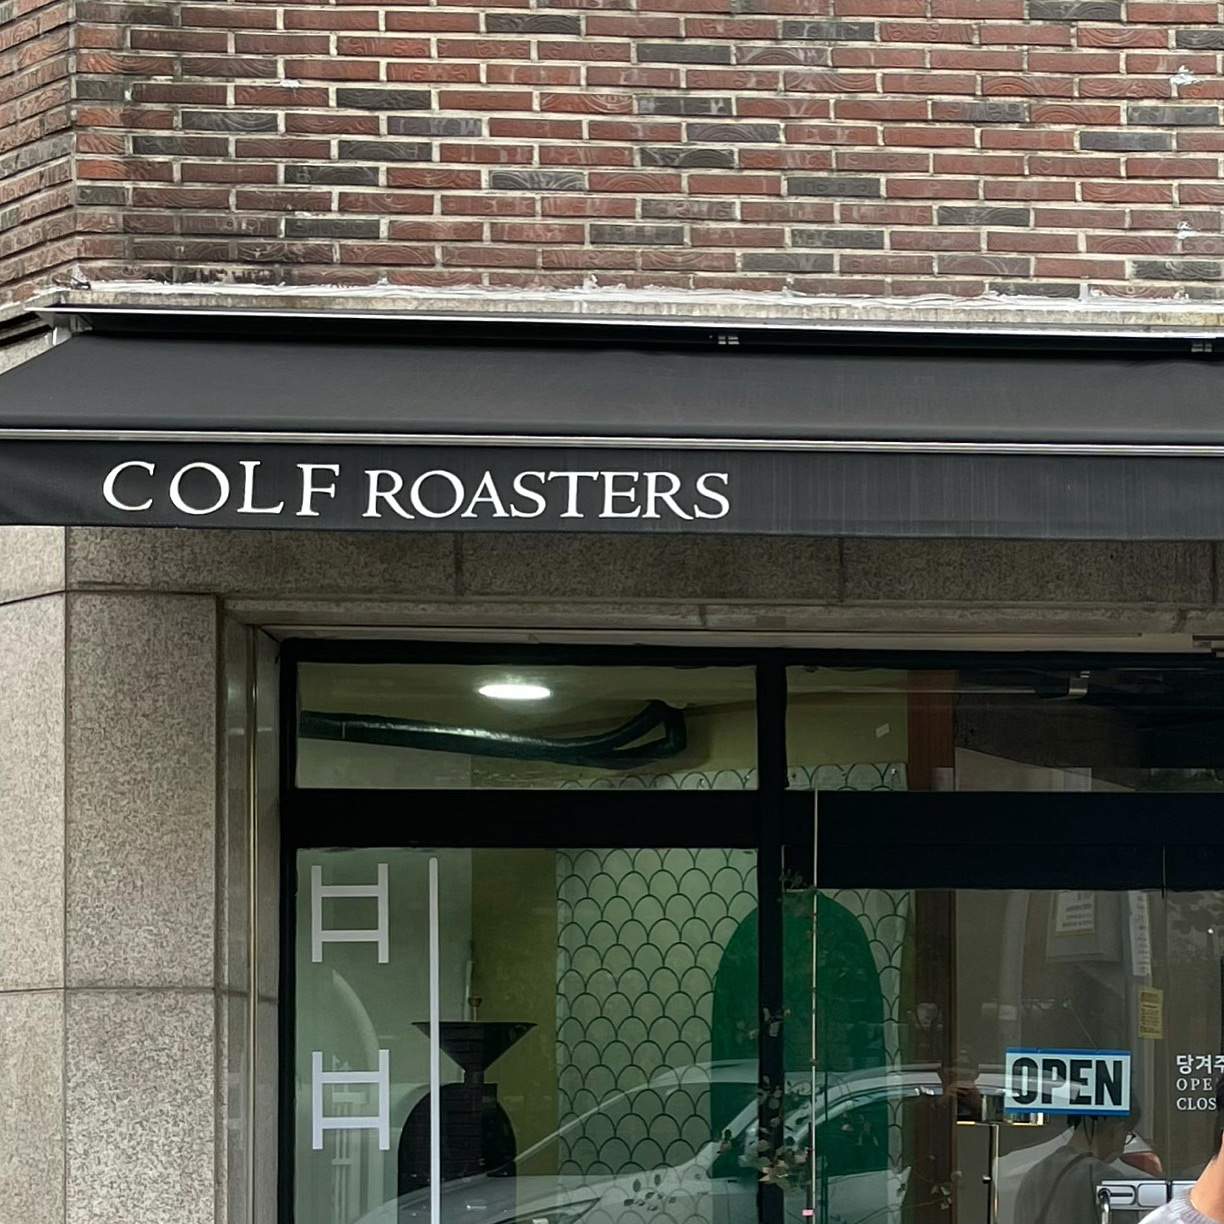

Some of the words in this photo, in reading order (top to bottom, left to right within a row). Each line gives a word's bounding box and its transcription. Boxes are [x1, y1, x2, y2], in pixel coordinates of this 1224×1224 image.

[102, 460, 340, 516] COLF
[362, 469, 731, 520] ROASTERS
[1011, 1056, 1122, 1106] OPEN
